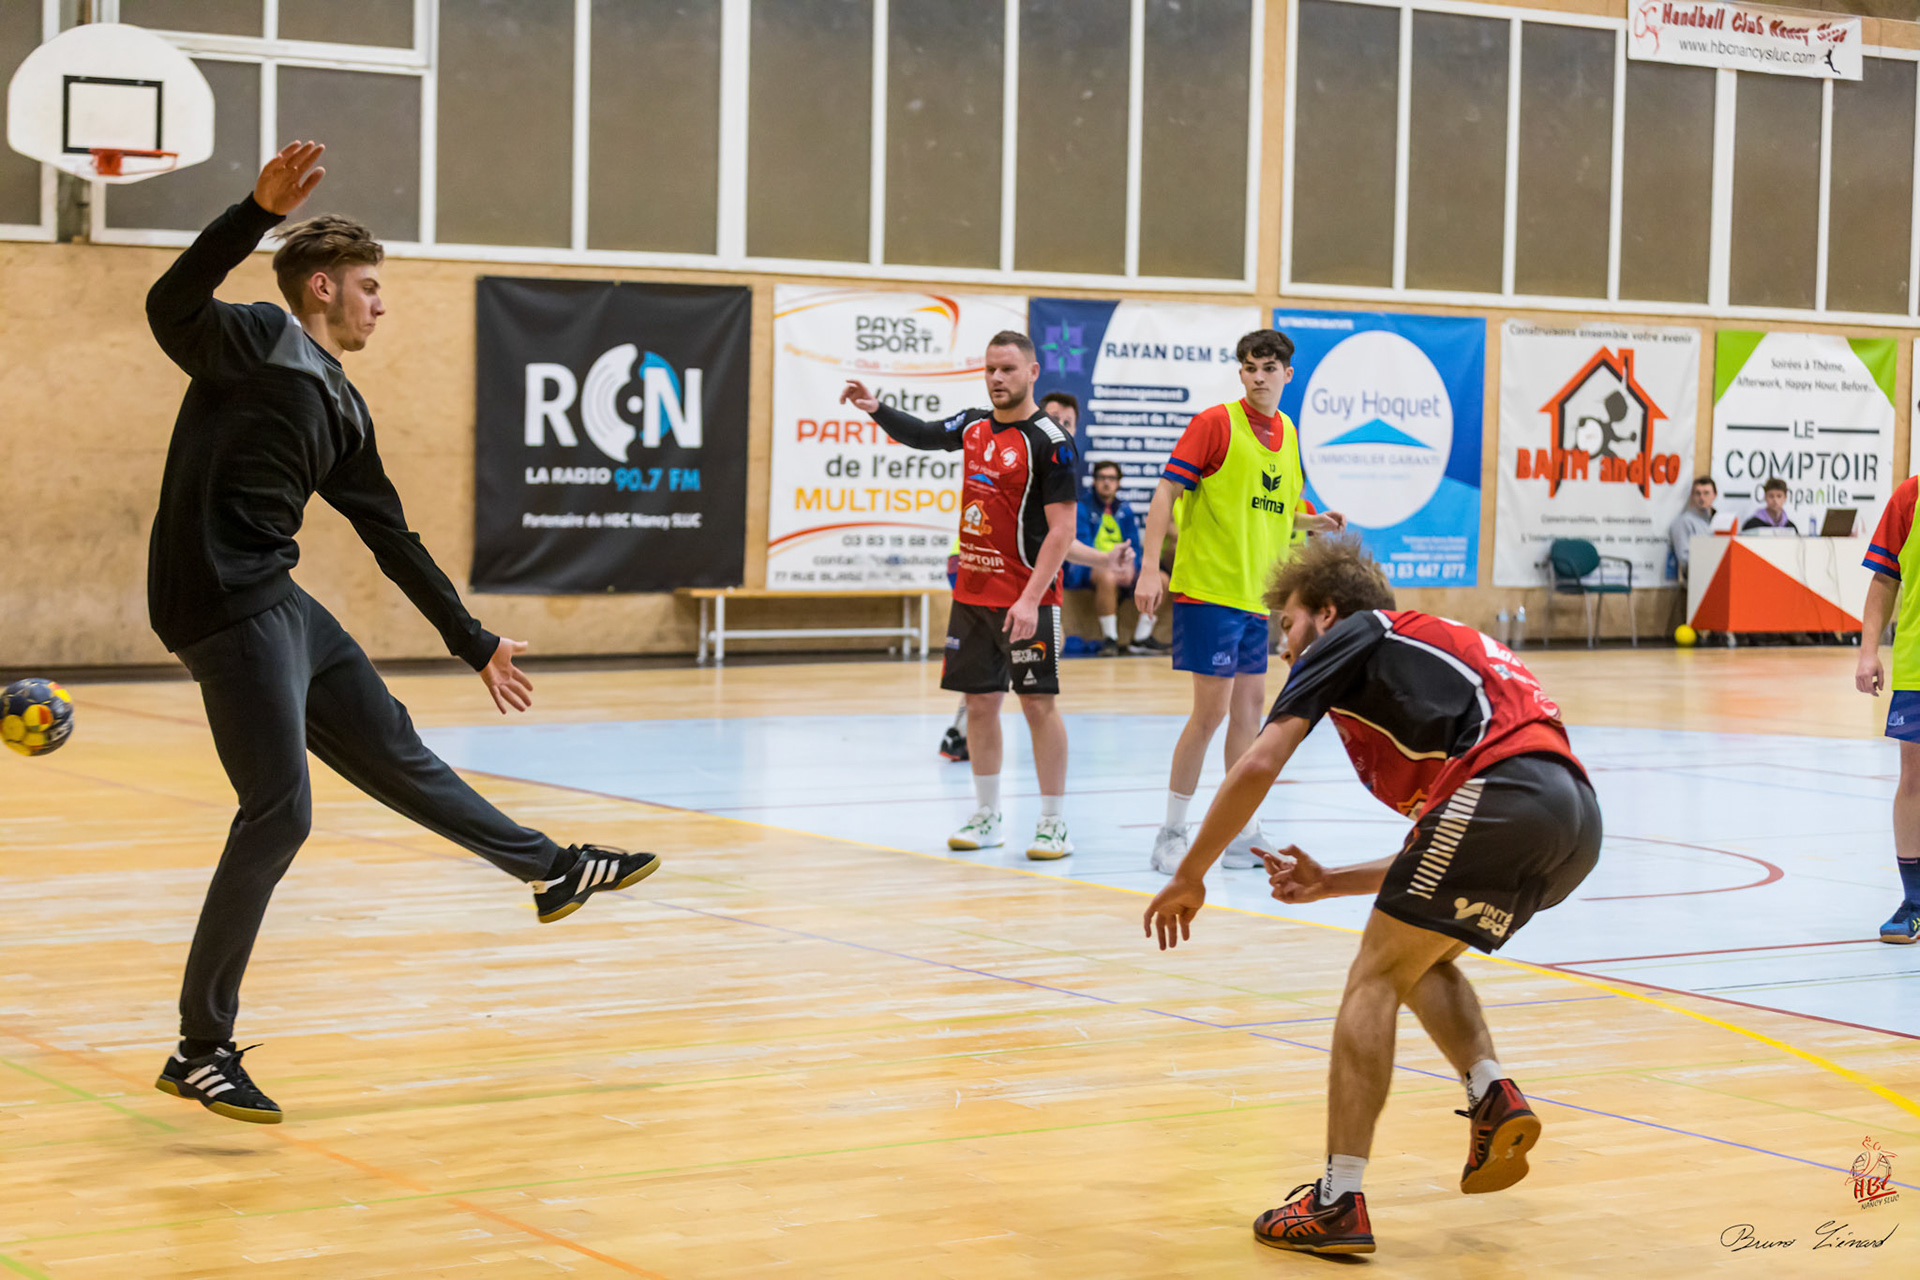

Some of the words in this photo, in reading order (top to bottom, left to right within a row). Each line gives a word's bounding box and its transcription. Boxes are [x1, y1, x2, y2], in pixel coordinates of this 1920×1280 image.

[1662, 3, 1725, 30] Handball
[1732, 12, 1764, 36] Club
[1769, 19, 1810, 46] Nancy
[1679, 39, 1816, 65] www.hbcnancysluc.com
[856, 315, 916, 335] PAYS
[1579, 327, 1628, 340] ensemble
[1632, 329, 1658, 341] votre
[1661, 330, 1692, 343] avenir
[1105, 342, 1167, 360] RAYAN
[1173, 345, 1212, 362] DEM
[1771, 358, 1801, 371] Soirées
[1805, 359, 1810, 371] à
[1813, 360, 1846, 373] Thème,
[1737, 376, 1783, 390] Afterwork,
[1785, 379, 1813, 393] Happy
[1815, 380, 1840, 393] Hour,
[1311, 388, 1354, 421] Guy
[1361, 390, 1441, 422] Hoquet
[1794, 420, 1815, 439] LE
[826, 455, 860, 478] de
[1599, 450, 1644, 483] and
[1725, 450, 1879, 482] COMPTOIR
[525, 467, 549, 485] LA
[551, 467, 612, 485] RADIO
[614, 467, 663, 491] 90.7
[669, 468, 701, 491] FM
[1251, 495, 1285, 515] erima
